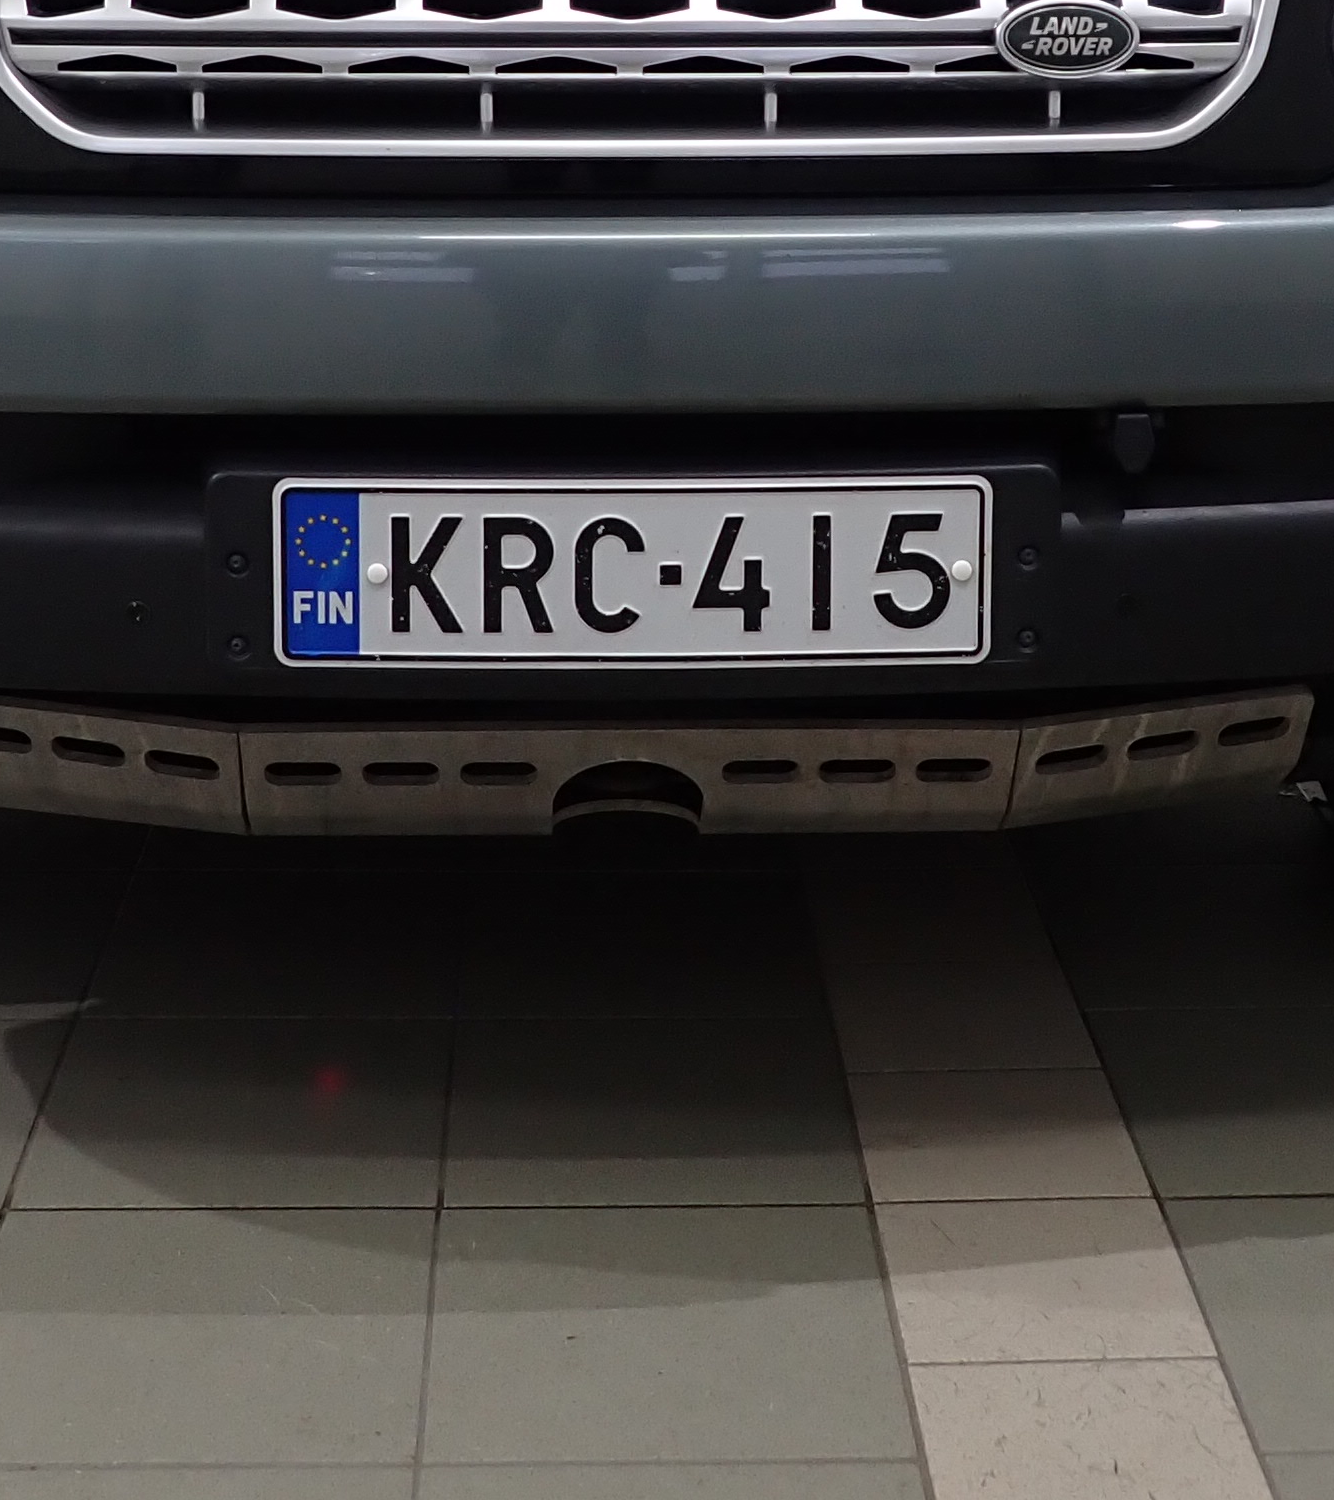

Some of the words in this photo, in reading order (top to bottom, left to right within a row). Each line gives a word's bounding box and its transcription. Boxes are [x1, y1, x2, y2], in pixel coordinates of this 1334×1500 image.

[1029, 16, 1094, 35] LAND
[1035, 37, 1113, 56] ROVER
[389, 513, 952, 635] KRC-415
[292, 590, 354, 626] FIN
